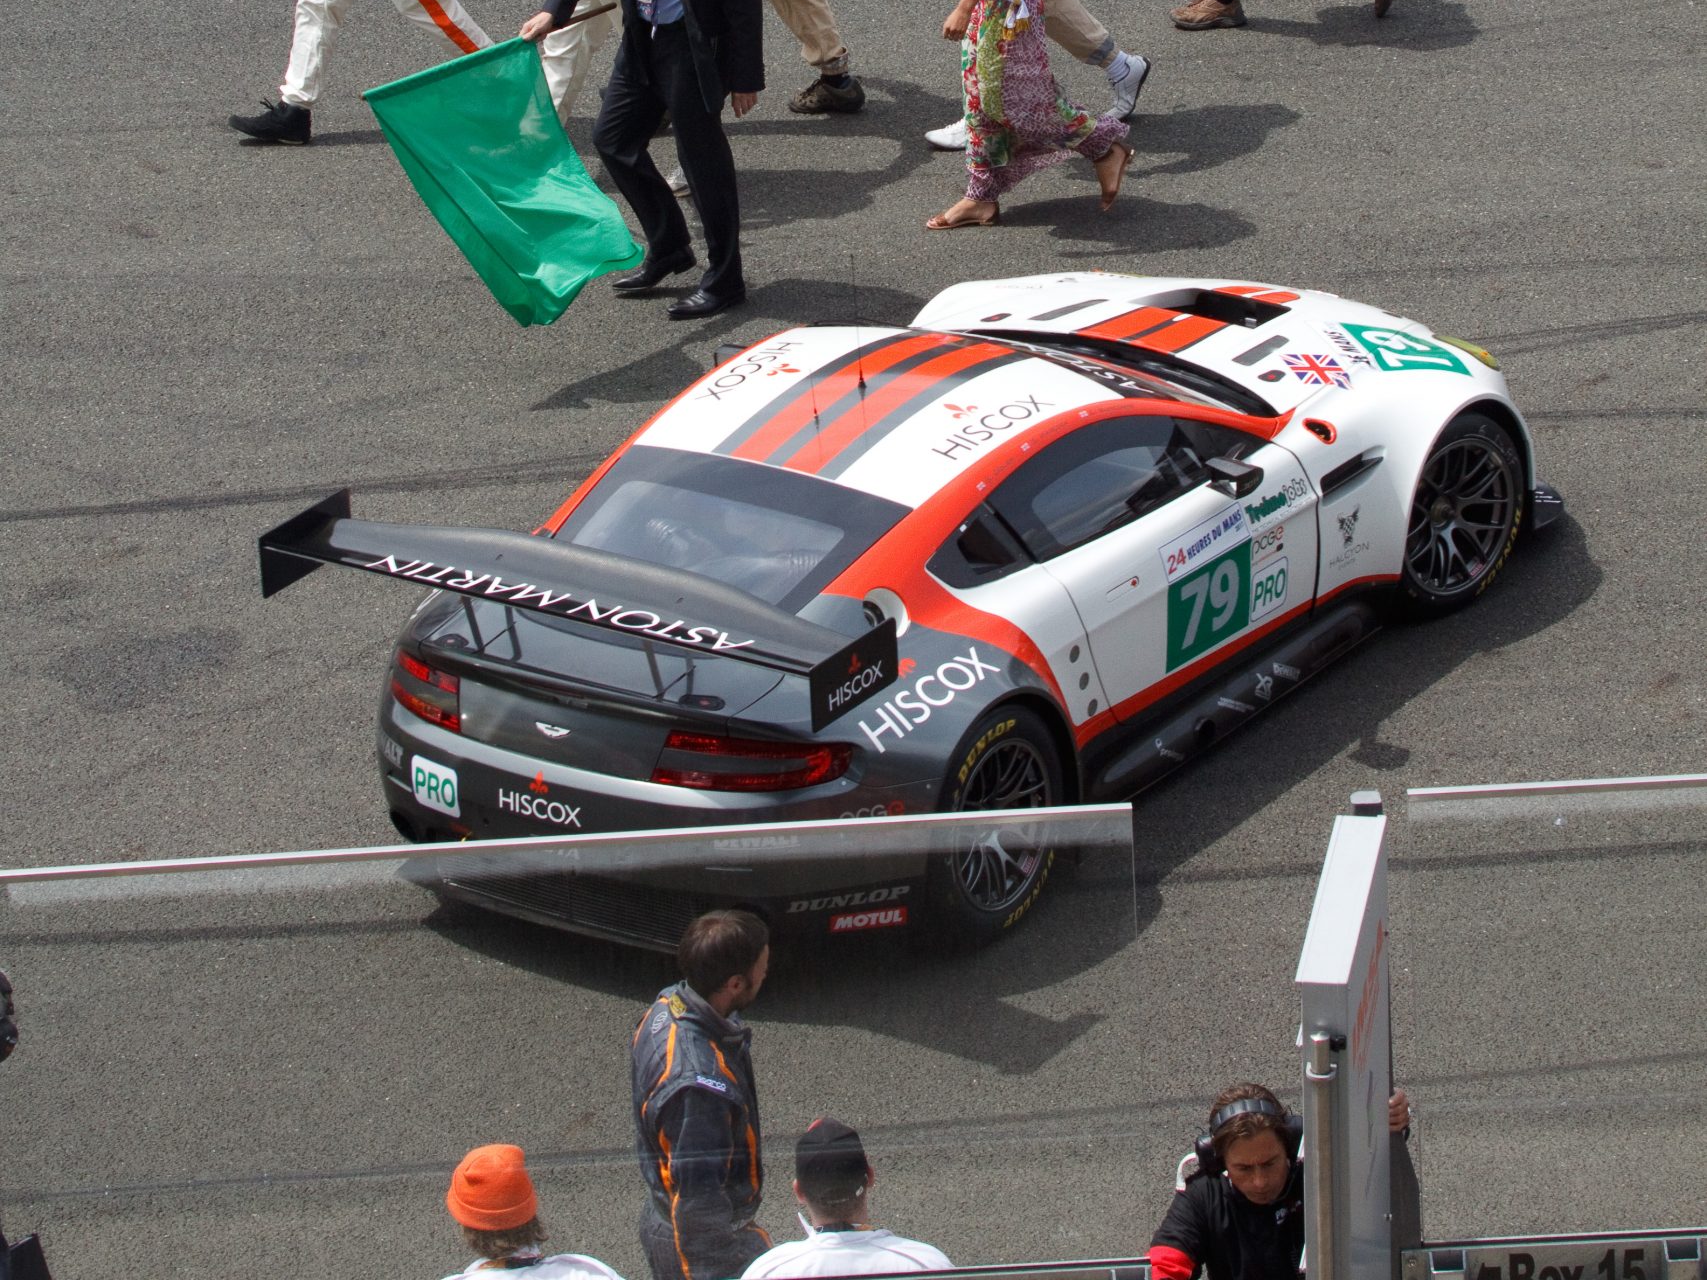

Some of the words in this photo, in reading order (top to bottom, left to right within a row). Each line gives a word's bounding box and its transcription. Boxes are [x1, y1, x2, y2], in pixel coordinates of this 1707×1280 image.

[695, 341, 803, 401] HISCOX
[932, 393, 1056, 460] HISCOX
[1167, 547, 1186, 575] 24
[1187, 533, 1212, 560] HEURES
[1212, 524, 1222, 540] DU
[1222, 509, 1242, 532] MANS
[365, 554, 571, 608] MARTIN
[1181, 559, 1239, 649] 79
[1253, 568, 1286, 612] PRO
[567, 598, 756, 650] ASTON
[828, 660, 883, 712] HISCOX
[858, 646, 1001, 754] HISCOX
[958, 719, 1017, 785] DUNLOP
[415, 766, 456, 809] PRO
[499, 787, 581, 827] HISCOX
[786, 885, 911, 914] DUNLOP
[834, 910, 903, 930] MOTUL
[1597, 1248, 1645, 1280] 15
